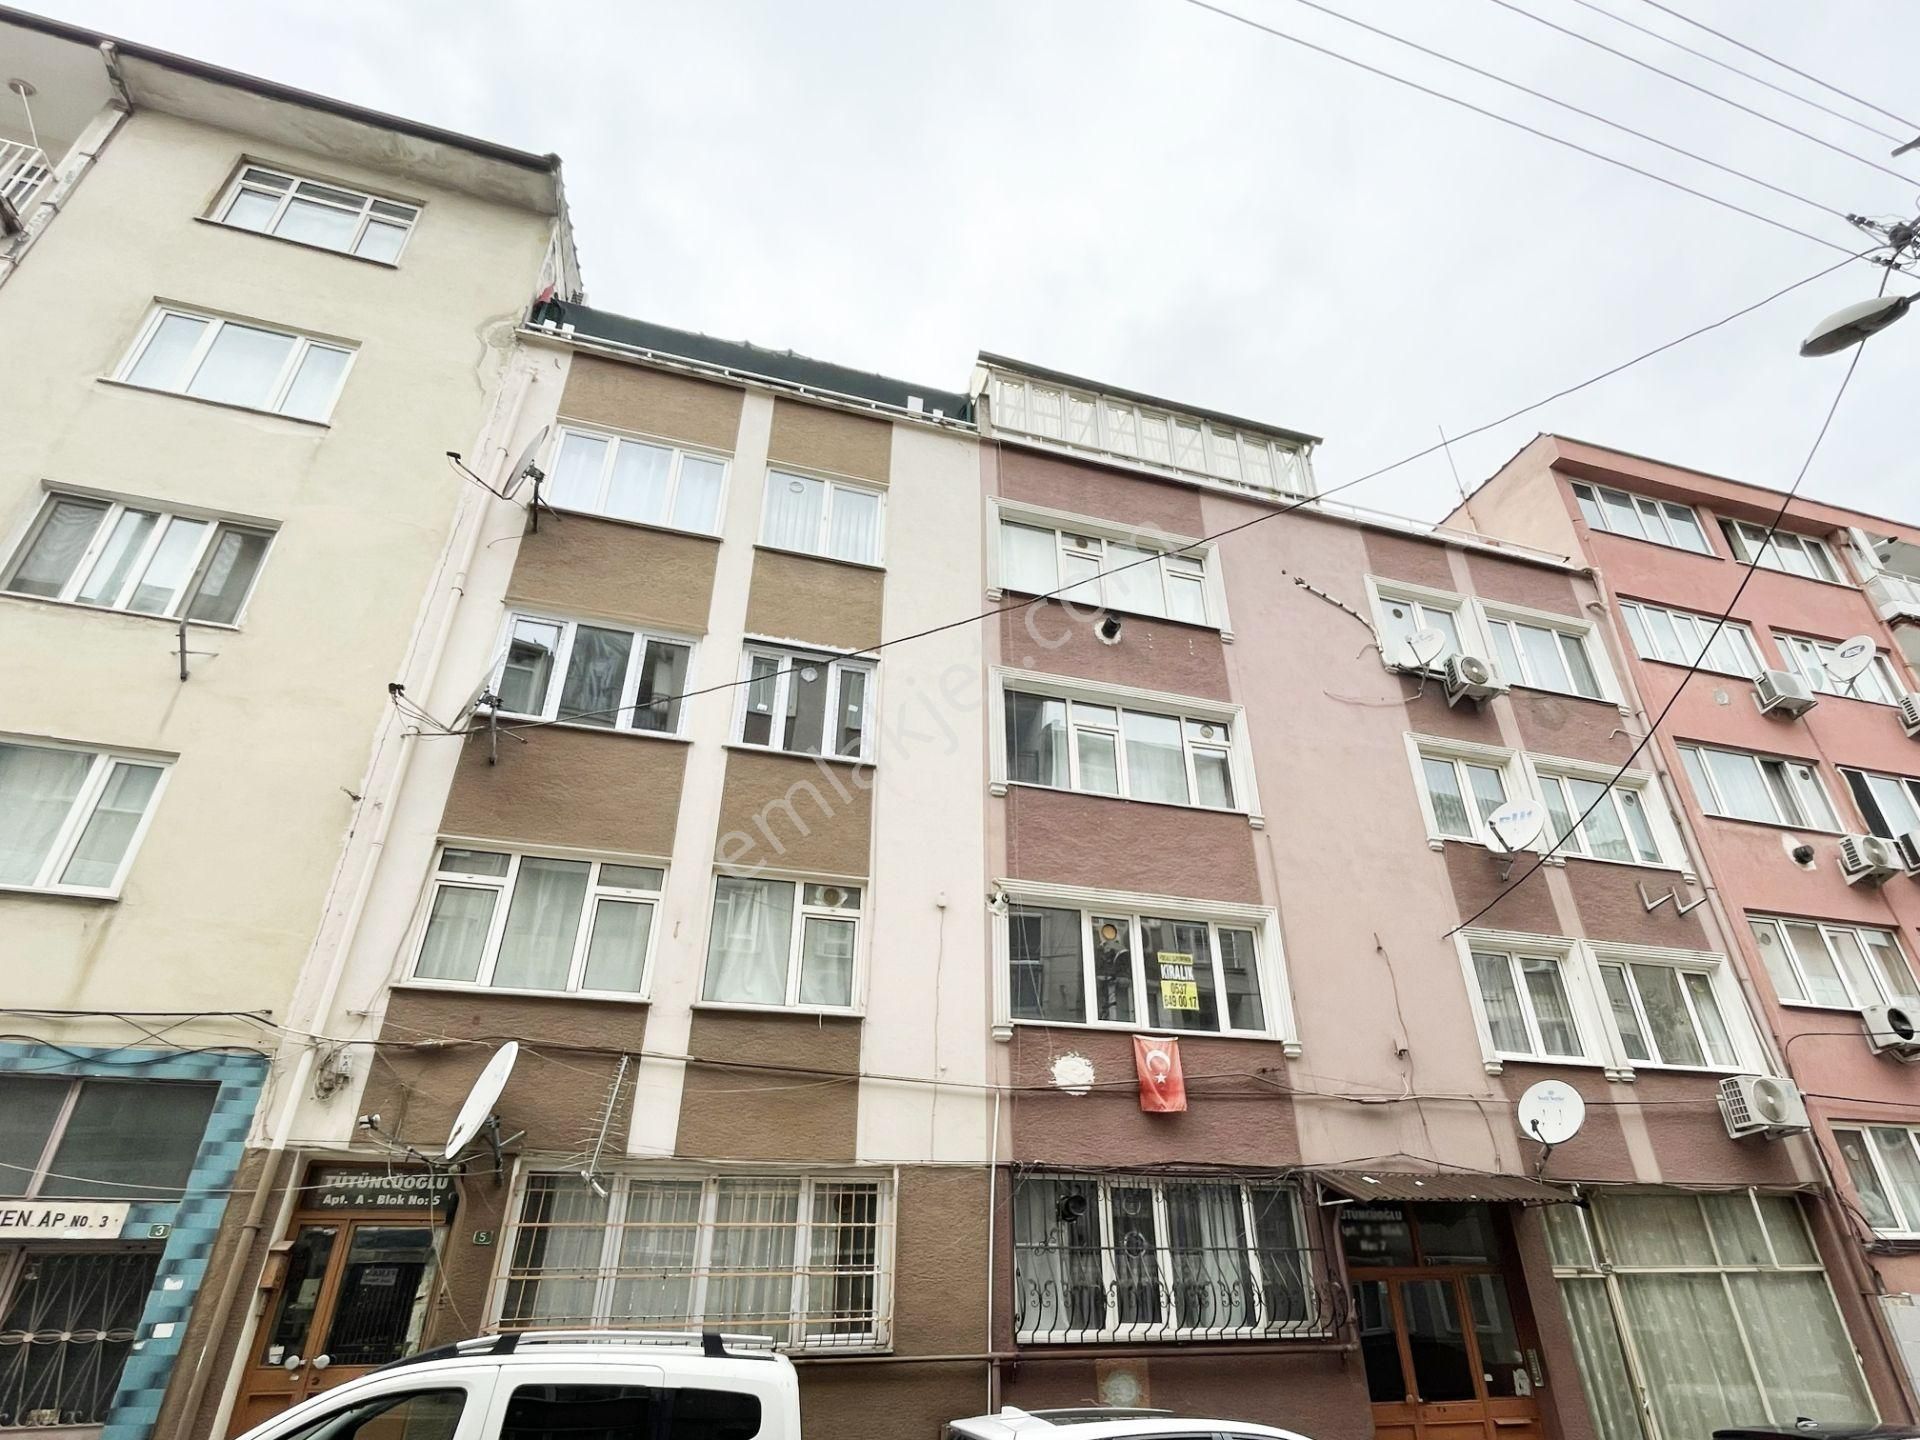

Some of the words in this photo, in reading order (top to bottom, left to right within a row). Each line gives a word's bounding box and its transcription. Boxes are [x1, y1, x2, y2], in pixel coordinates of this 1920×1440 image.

[1178, 995, 1187, 1007] 00
[1189, 996, 1196, 1008] 17
[322, 1194, 348, 1206] Apt.
[354, 1194, 364, 1204] A
[376, 1194, 405, 1205] Blok
[99, 1215, 109, 1228] 3
[154, 1225, 165, 1236] 3
[479, 1232, 486, 1242] 5
